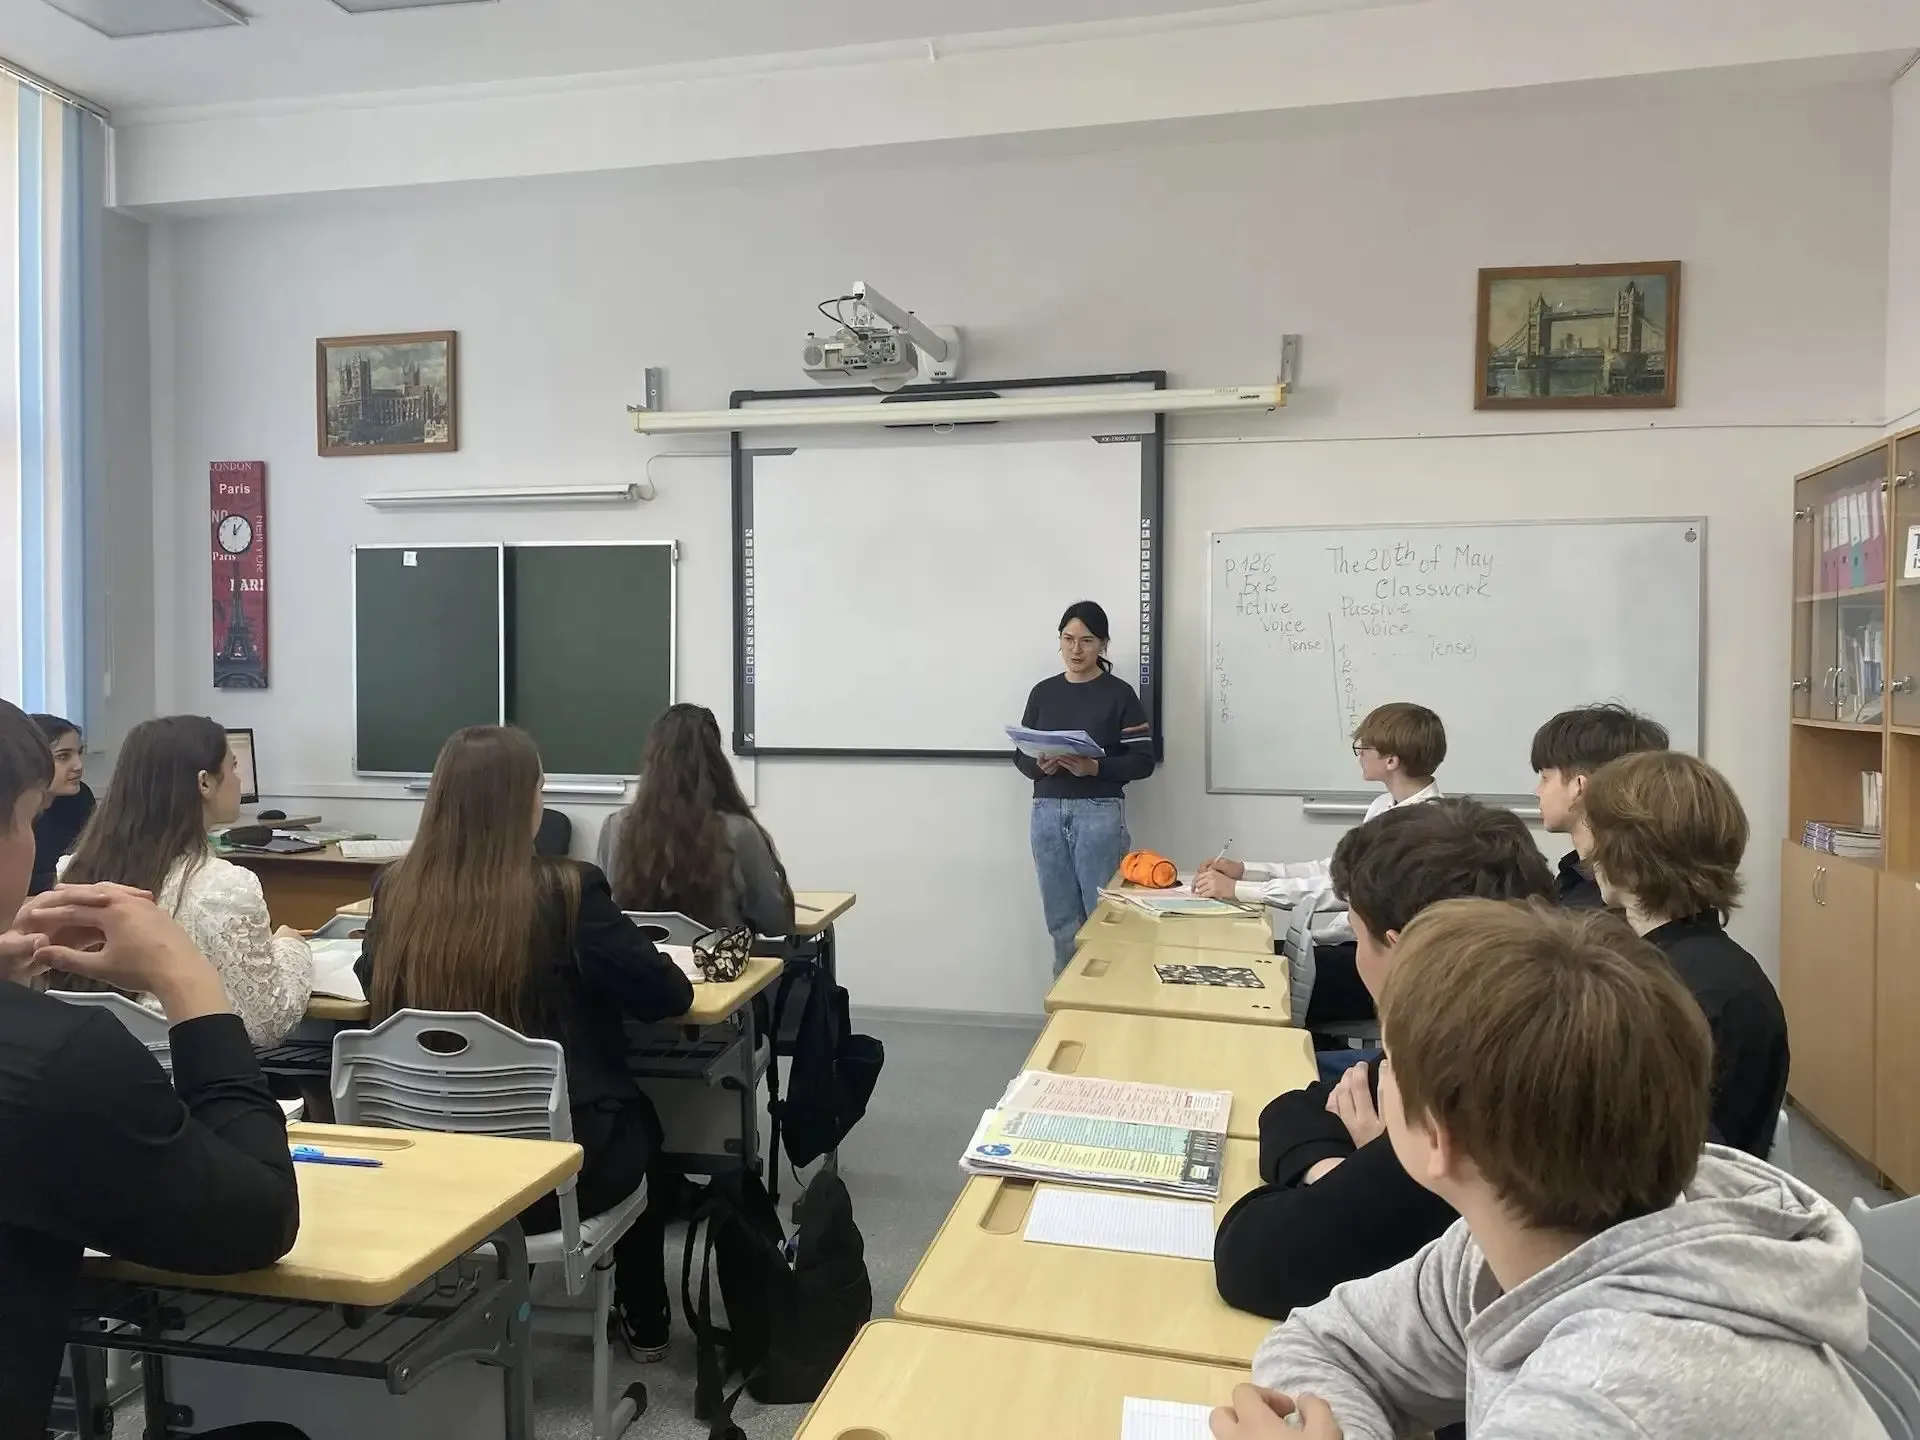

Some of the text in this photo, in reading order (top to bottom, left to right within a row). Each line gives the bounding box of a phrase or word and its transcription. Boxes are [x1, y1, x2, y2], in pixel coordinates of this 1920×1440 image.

[219, 483, 251, 495] Paris
[212, 551, 237, 561] Paris
[1325, 545, 1361, 575] The
[1419, 544, 1442, 574] of
[1453, 544, 1494, 578] May
[1375, 574, 1492, 600] Classwork
[1236, 592, 1293, 617] Active
[1341, 595, 1411, 618] Passive
[1260, 615, 1306, 633] Voice
[1361, 618, 1414, 637] Voice
